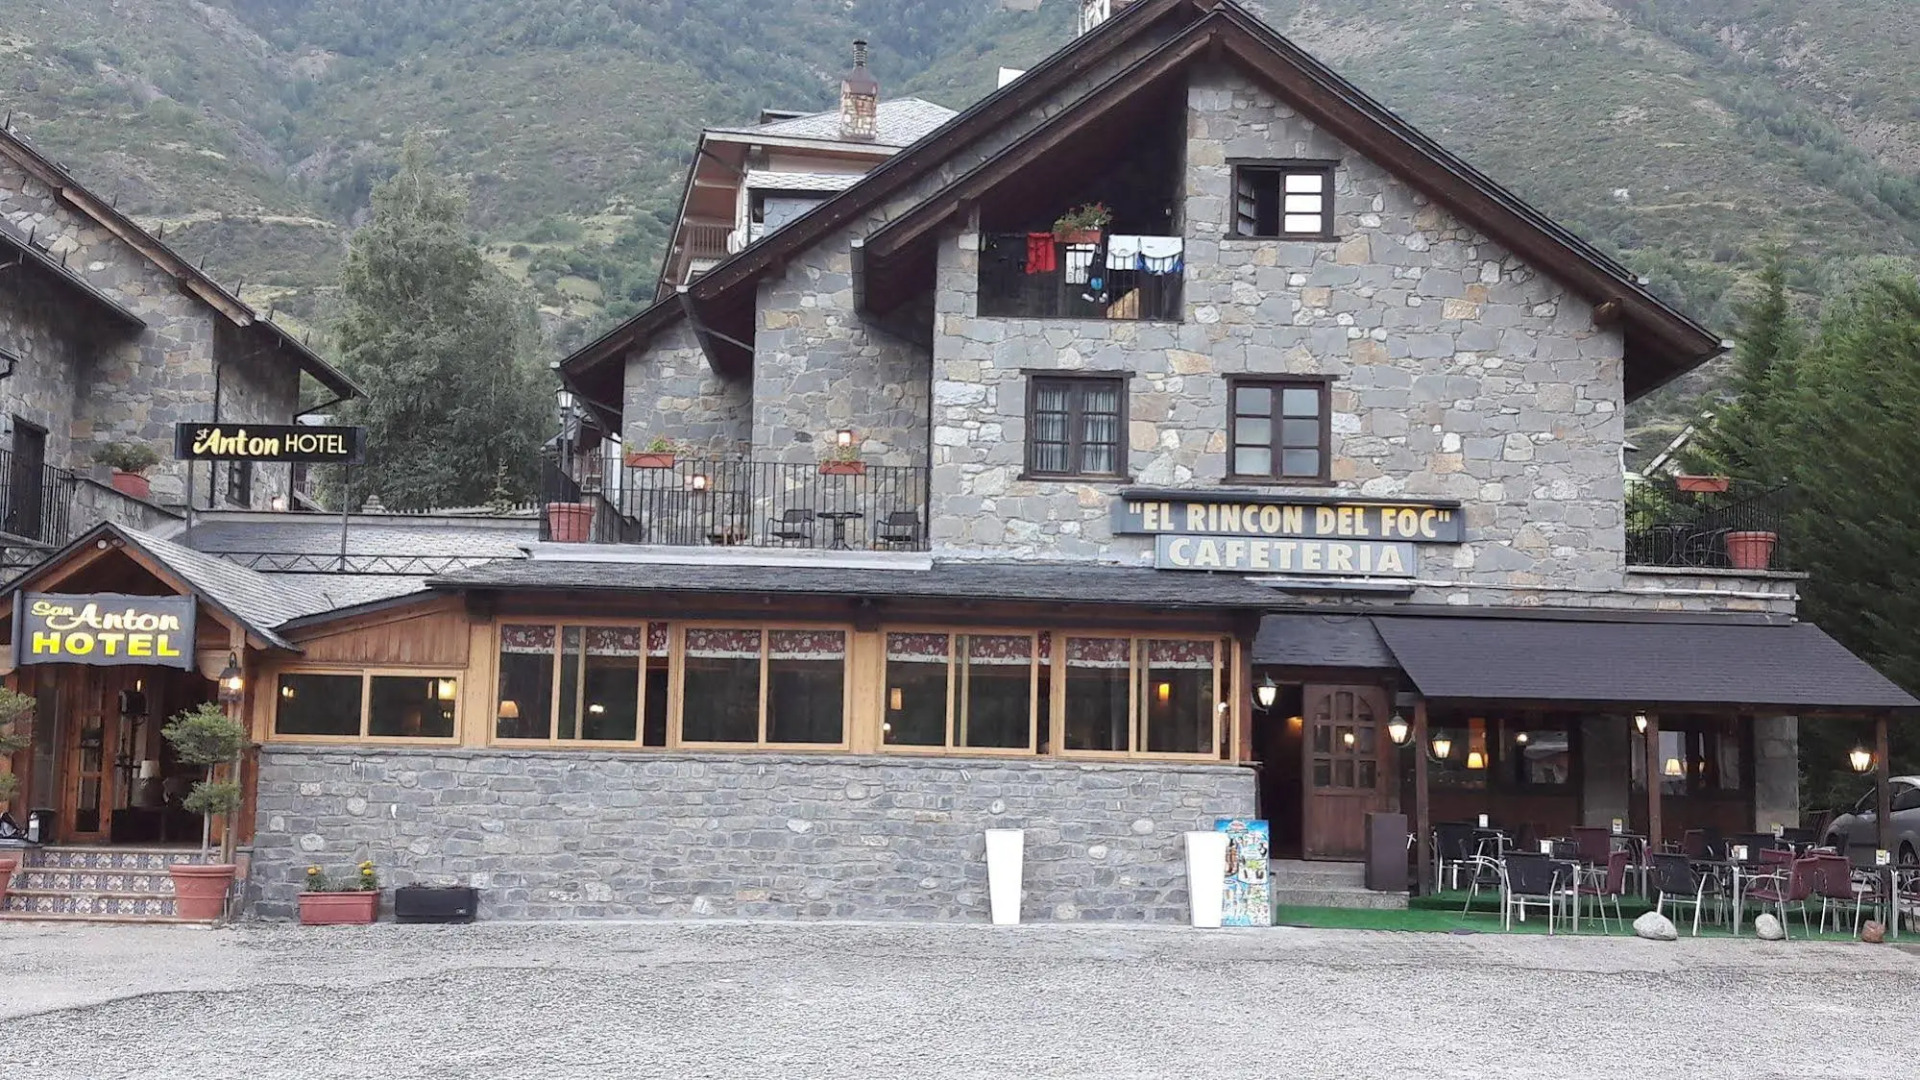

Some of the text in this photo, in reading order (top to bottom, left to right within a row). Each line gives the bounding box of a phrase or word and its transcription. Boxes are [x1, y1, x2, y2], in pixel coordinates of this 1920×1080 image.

[193, 427, 280, 457] Anton
[285, 433, 348, 454] HOTEL
[1186, 503, 1303, 534] RINCON
[1315, 507, 1369, 536] DEL
[1168, 537, 1405, 572] CAFETERIA
[31, 600, 180, 631] San Anton
[32, 632, 180, 657] HOTEL
